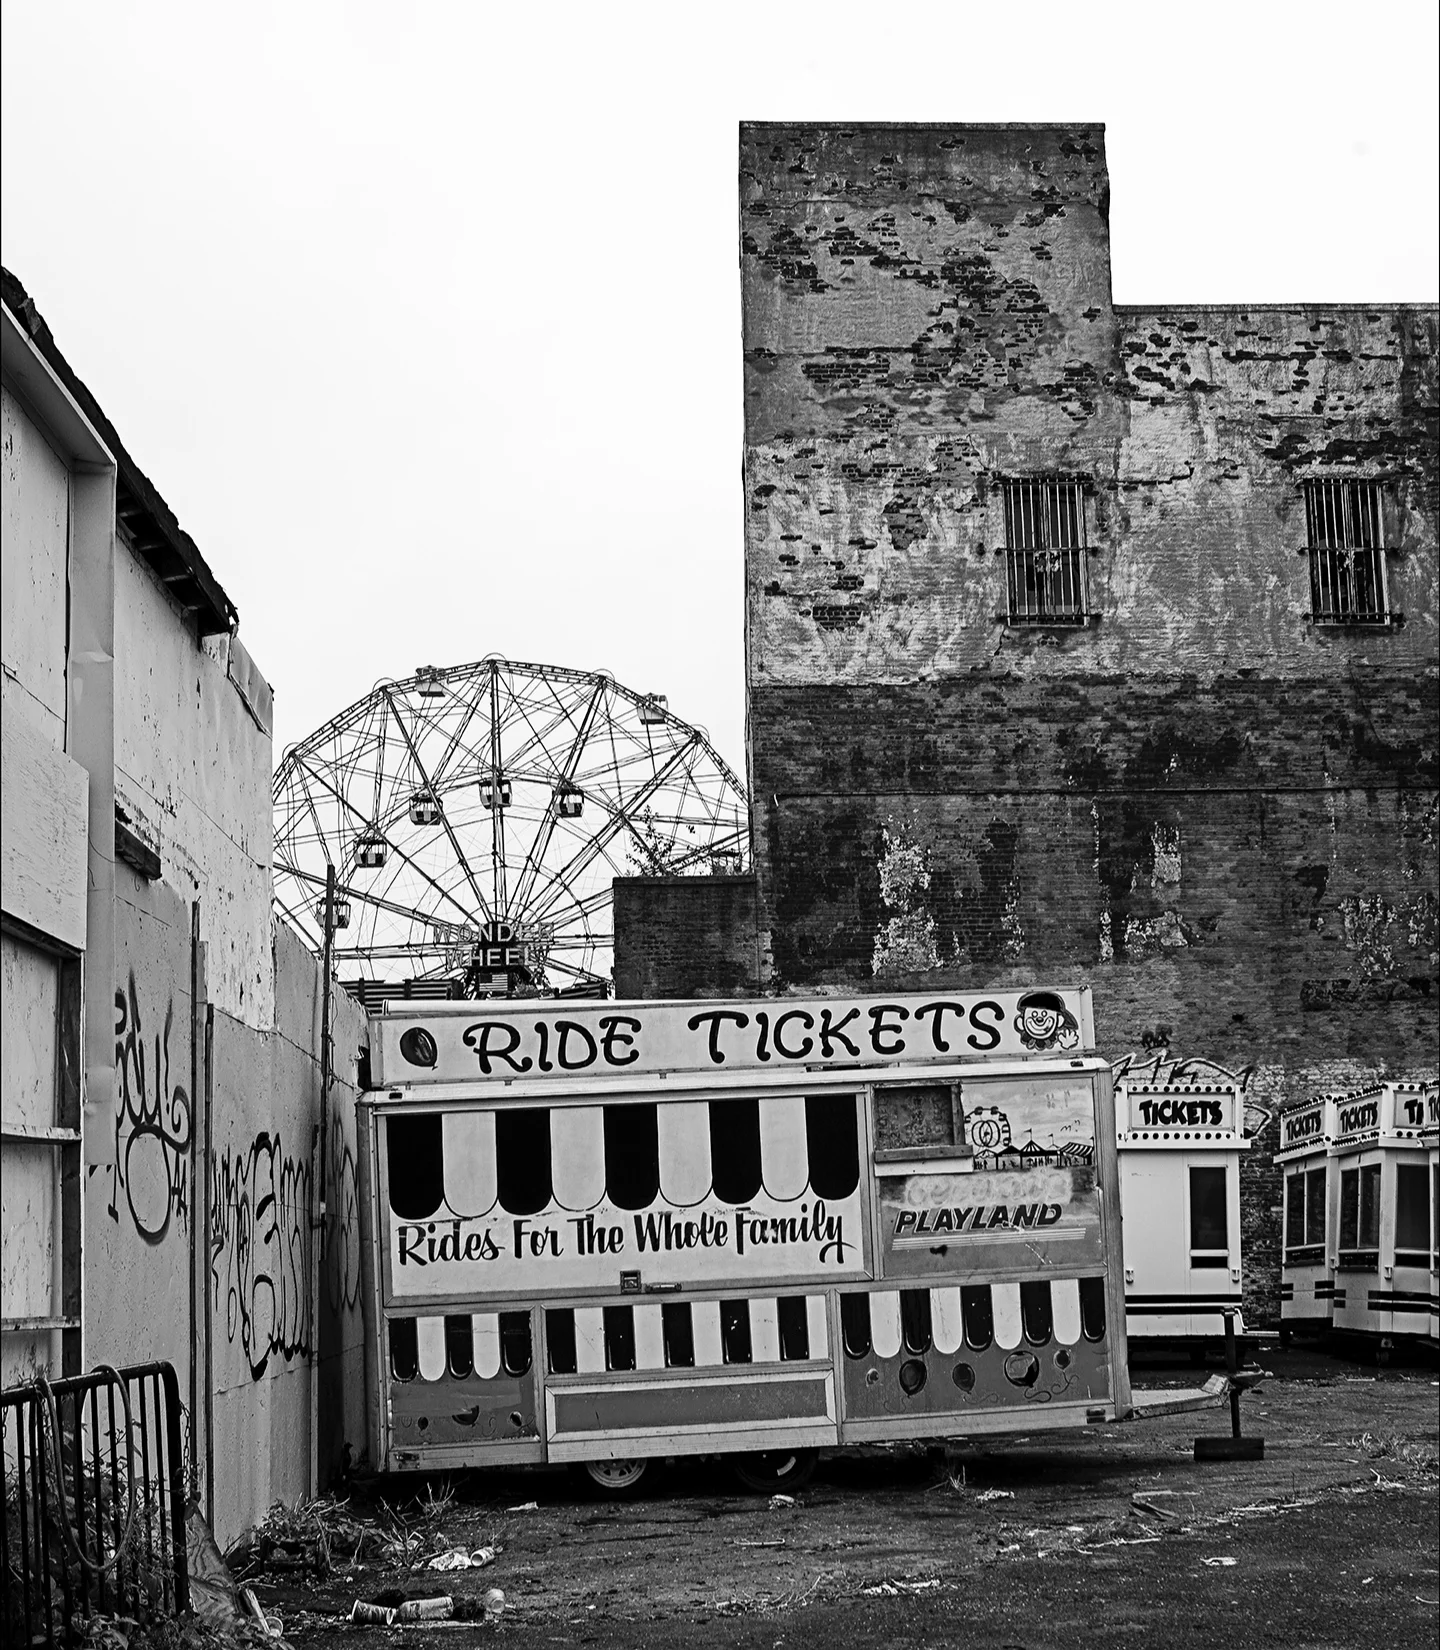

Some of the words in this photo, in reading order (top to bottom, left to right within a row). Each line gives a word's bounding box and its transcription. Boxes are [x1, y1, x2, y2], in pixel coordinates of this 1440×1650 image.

[433, 922, 554, 943] WONDER
[446, 947, 539, 969] WHEEL
[463, 1016, 642, 1074] RIDE
[688, 1001, 1005, 1063] TICKETS
[1139, 1100, 1223, 1126] TICKETS
[1286, 1110, 1321, 1141] TICKETS
[1340, 1101, 1378, 1133] TICKETS
[397, 1222, 505, 1266] Rides
[513, 1219, 563, 1259] For
[567, 1213, 625, 1256] The
[634, 1212, 728, 1253] Whole
[734, 1200, 858, 1265] Family
[895, 1203, 1062, 1233] PLAYLAND
